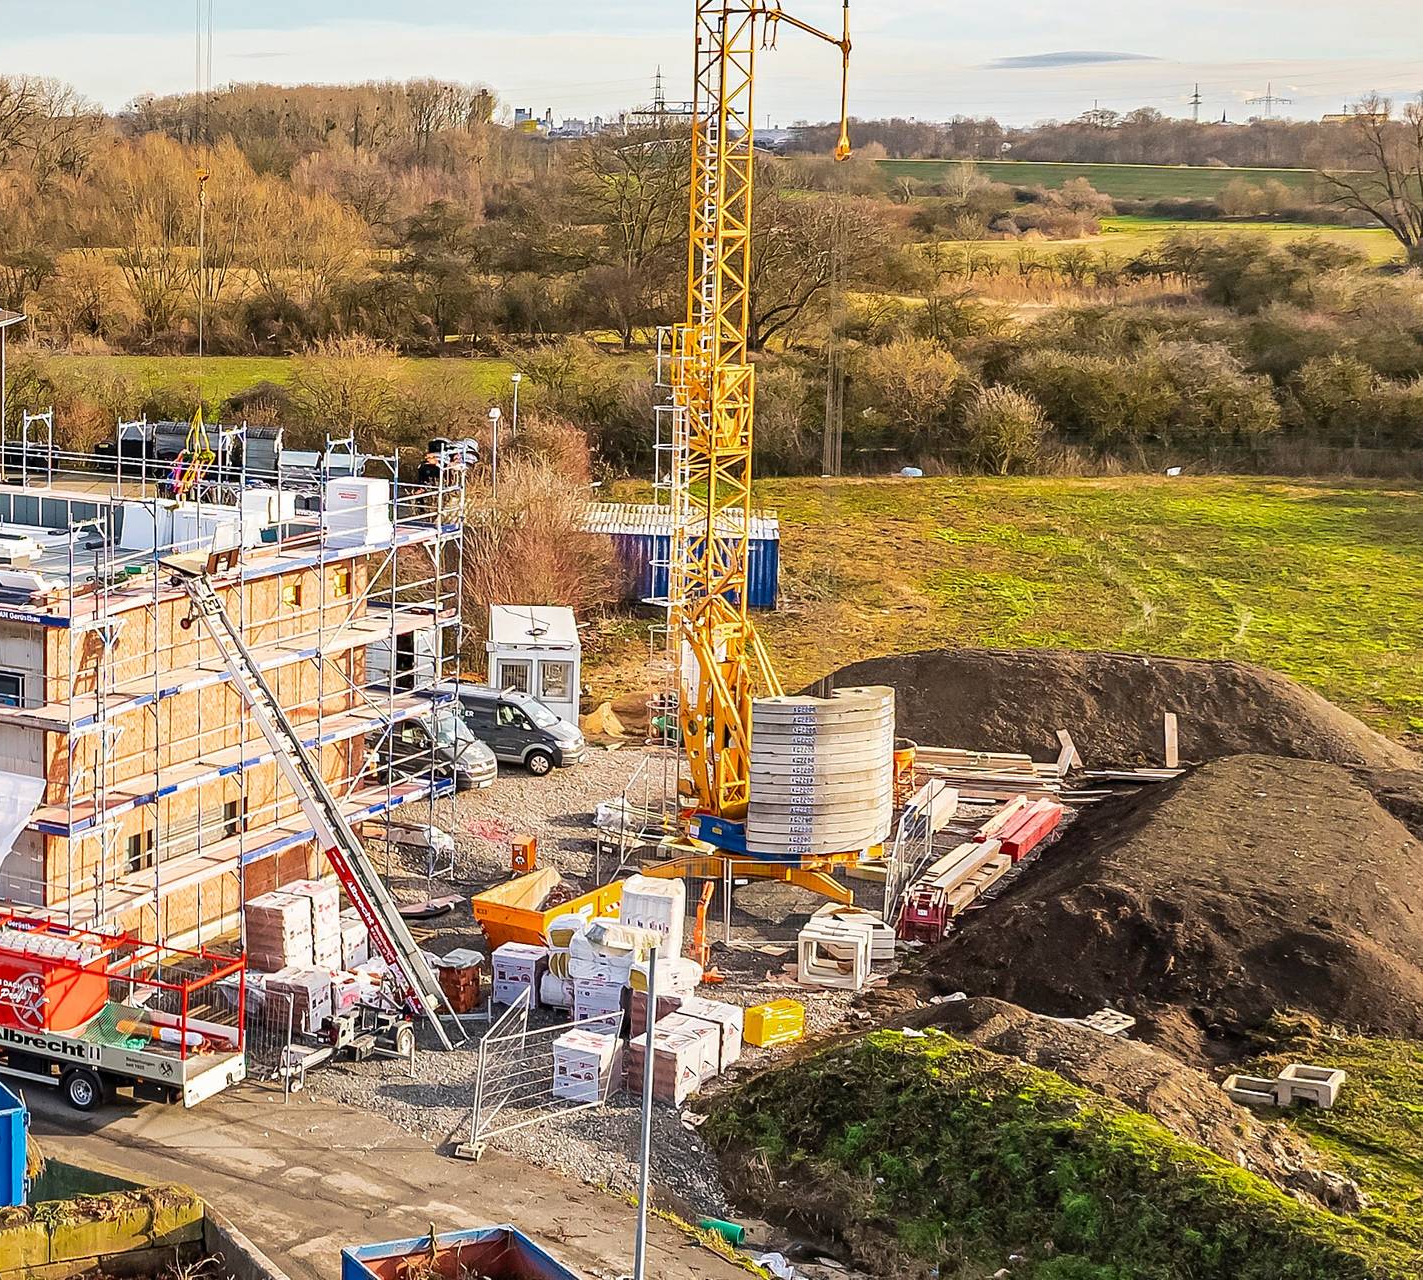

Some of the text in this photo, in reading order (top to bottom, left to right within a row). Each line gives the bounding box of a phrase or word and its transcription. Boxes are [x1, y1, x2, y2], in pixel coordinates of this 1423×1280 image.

[9, 612, 41, 623] Gerüstbau
[346, 880, 375, 926] Albrecht
[3, 979, 23, 990] DACH
[23, 984, 40, 994] VOM
[0, 987, 27, 1003] Profi
